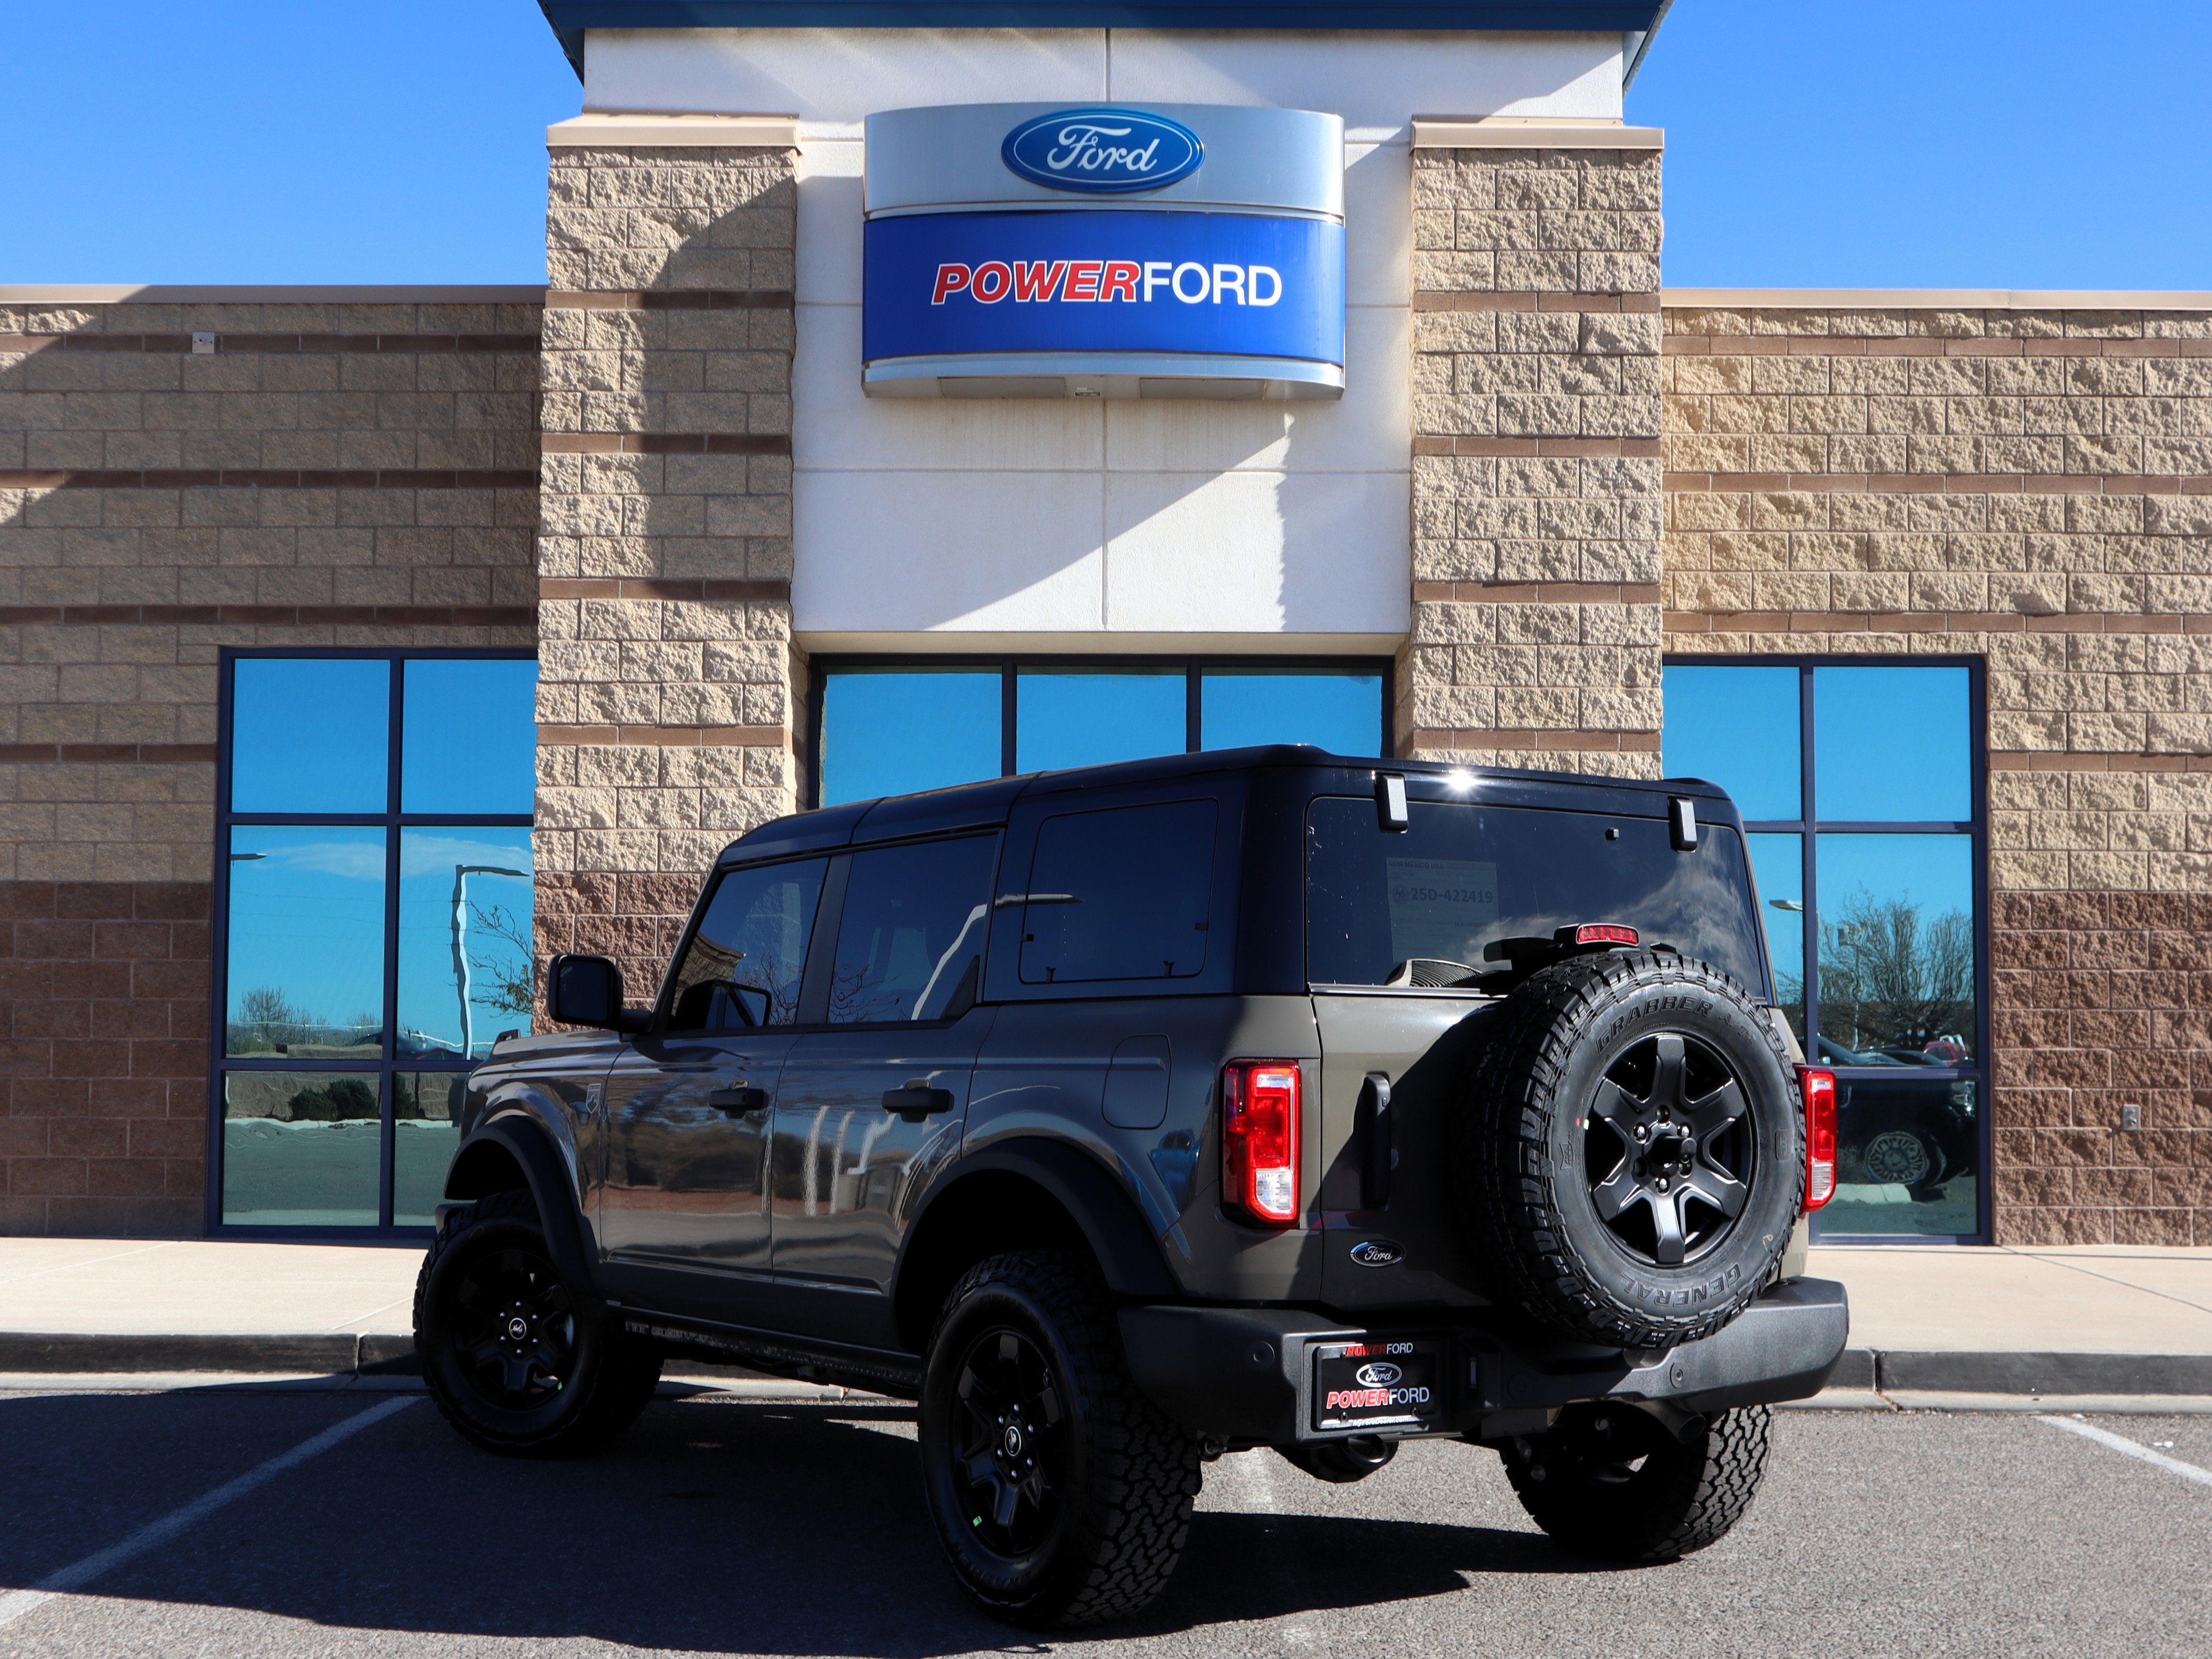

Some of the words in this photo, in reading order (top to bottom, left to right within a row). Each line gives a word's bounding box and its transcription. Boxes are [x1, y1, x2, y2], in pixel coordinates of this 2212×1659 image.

[1047, 125, 1160, 172] Ford
[930, 260, 1283, 307] POWERFORD
[1411, 888, 1493, 903] 25D-422419
[1596, 995, 1714, 1054] GRABBER
[1364, 1246, 1393, 1261] Ford
[1621, 1262, 1741, 1308] GENERAL
[1345, 1343, 1413, 1356] POWERFORD
[1365, 1367, 1393, 1382] Ford
[1326, 1387, 1430, 1409] POWERFORD
[1353, 1417, 1409, 1427] MyFordDealer.com
